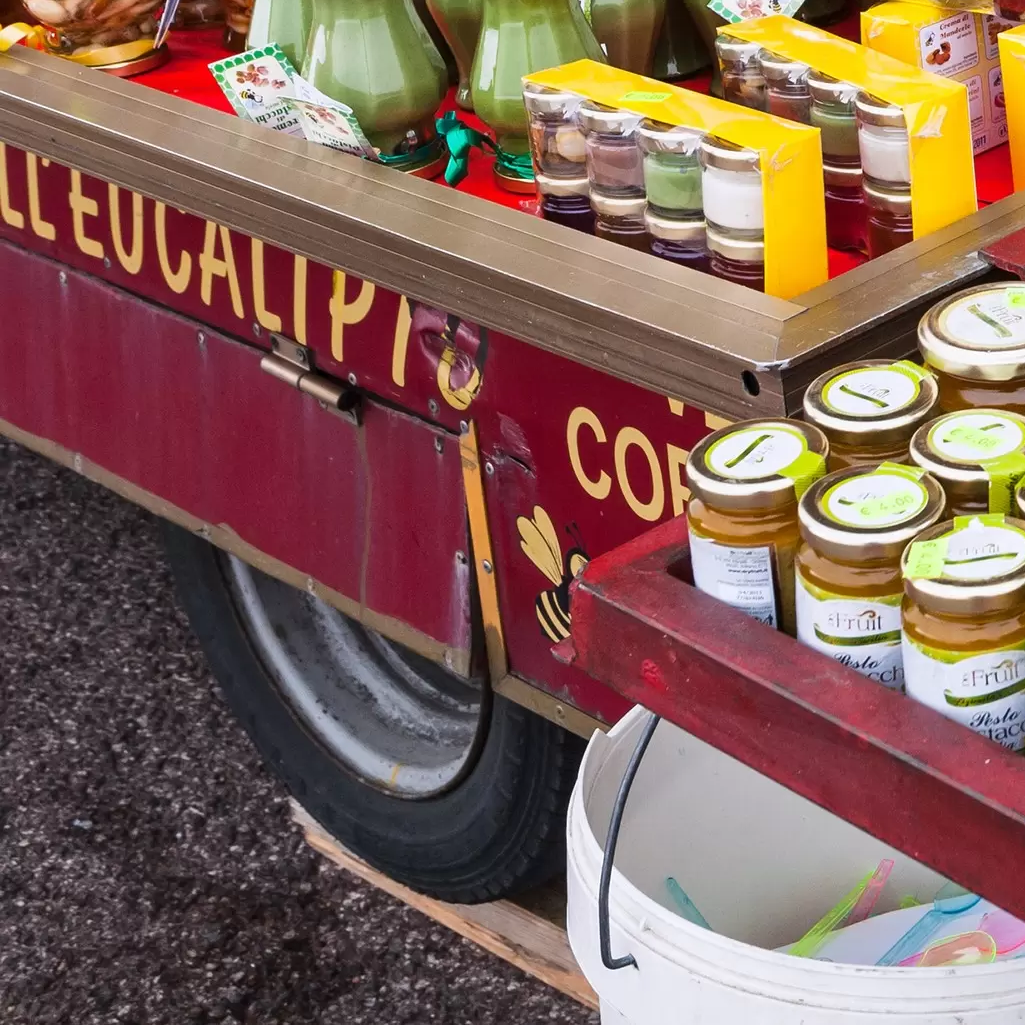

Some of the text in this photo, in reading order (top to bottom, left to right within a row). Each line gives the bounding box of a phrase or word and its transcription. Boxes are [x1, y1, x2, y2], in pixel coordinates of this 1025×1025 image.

[939, 18, 961, 31] Crema
[836, 609, 884, 631] Fruit
[971, 659, 1020, 687] Fruit
[969, 706, 1019, 728] Pesto
